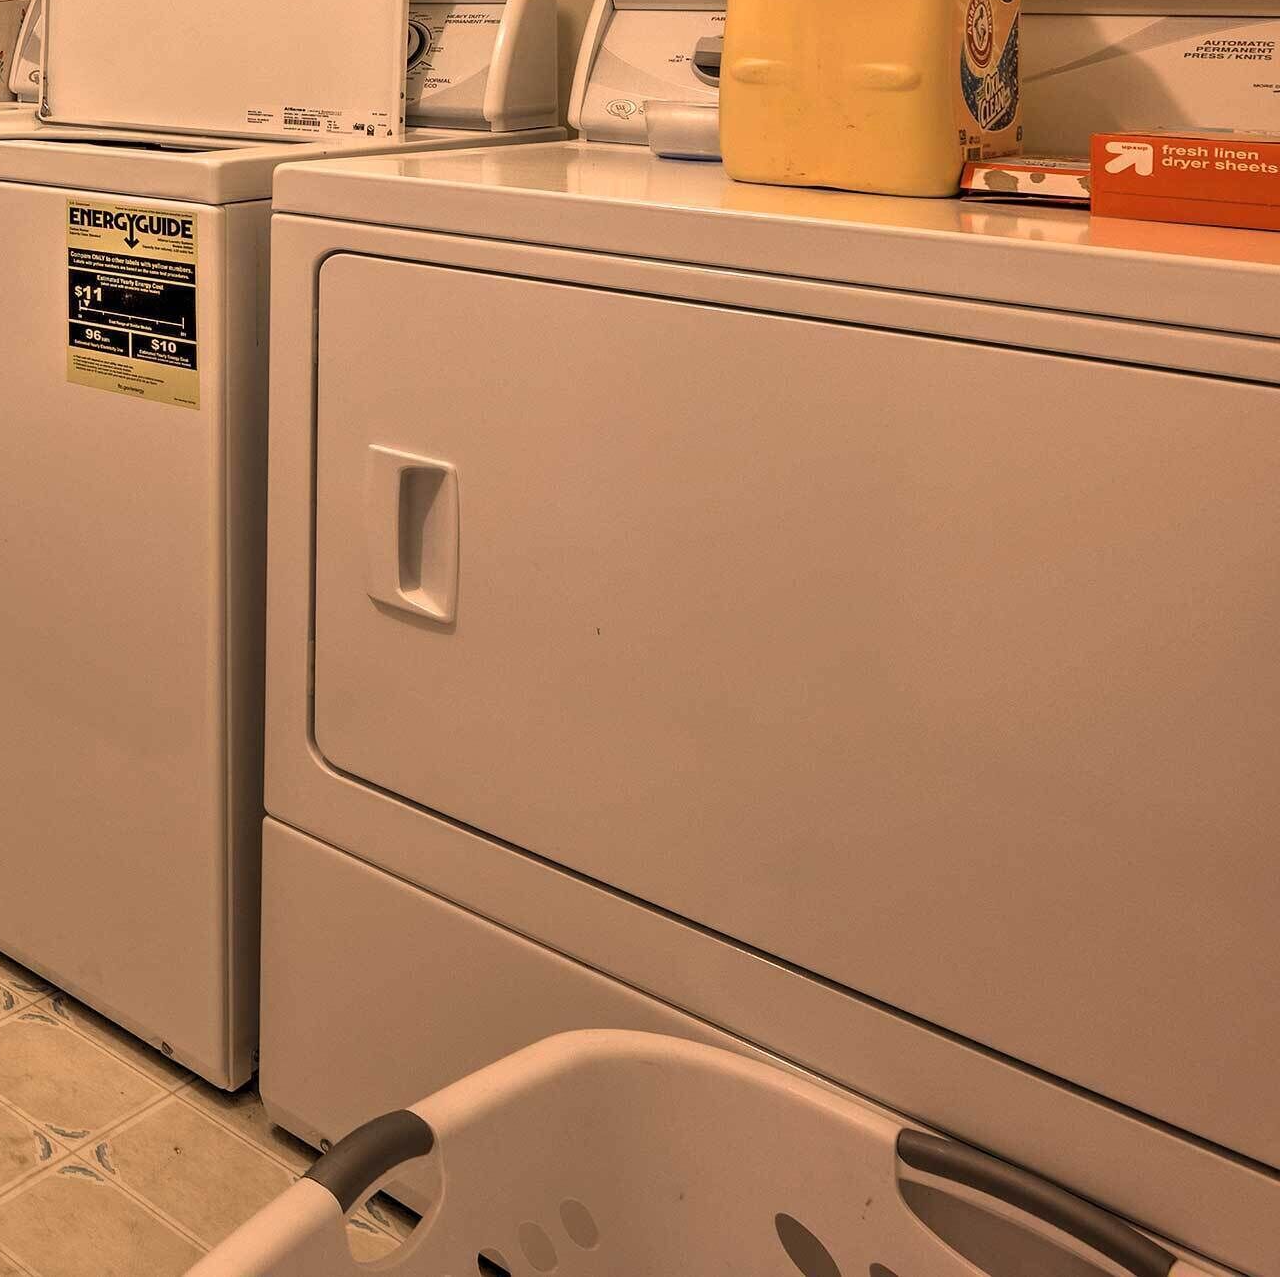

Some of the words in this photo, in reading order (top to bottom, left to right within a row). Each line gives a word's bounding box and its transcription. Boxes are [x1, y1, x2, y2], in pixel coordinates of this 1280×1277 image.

[1162, 144, 1208, 157] fresh
[1214, 147, 1259, 160] linen
[1161, 156, 1210, 170] dryer
[1215, 160, 1279, 174] sheets
[69, 207, 193, 239] ENERGYGUIDE
[120, 278, 134, 287] Yearly
[135, 280, 151, 290] Energy
[74, 285, 102, 301] $11
[85, 328, 101, 341] 96
[151, 338, 177, 353] $10
